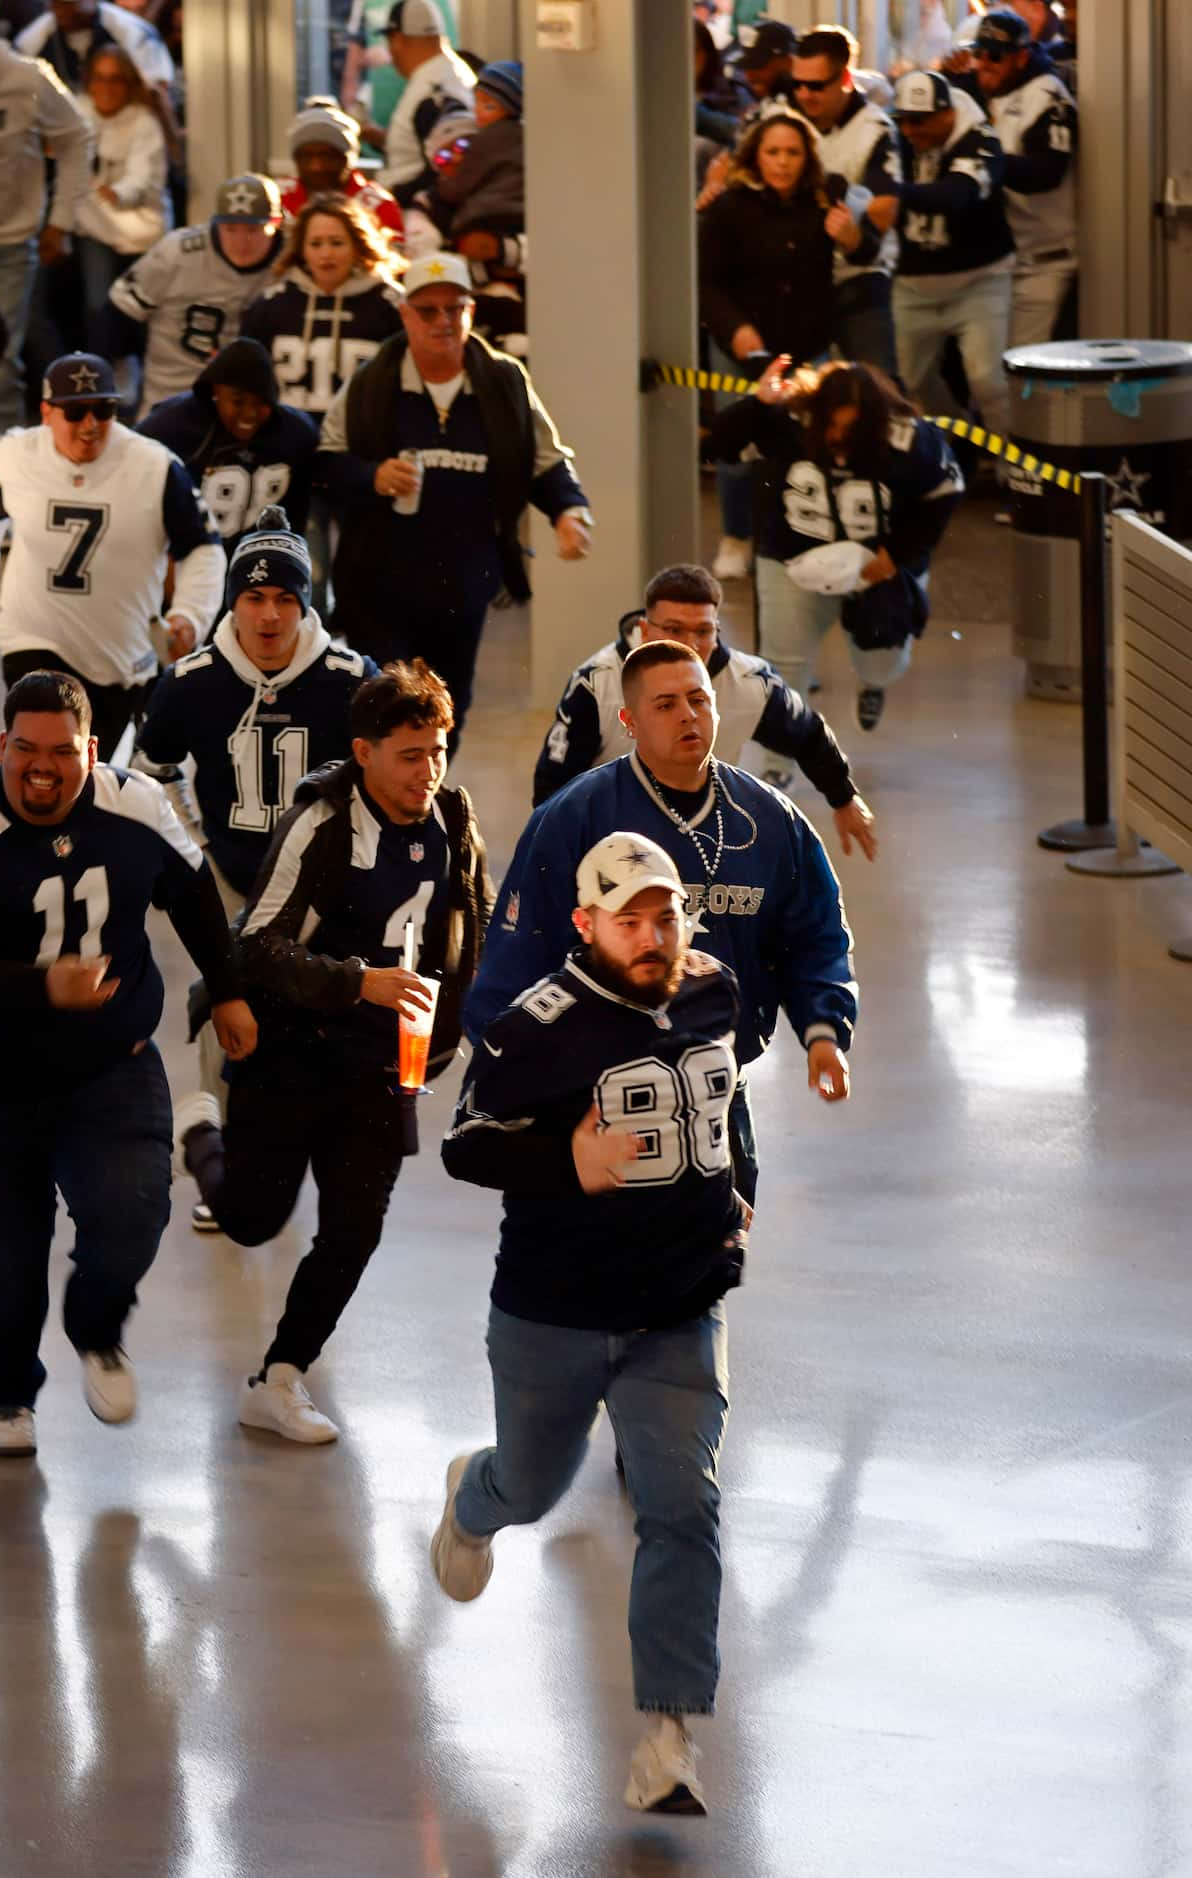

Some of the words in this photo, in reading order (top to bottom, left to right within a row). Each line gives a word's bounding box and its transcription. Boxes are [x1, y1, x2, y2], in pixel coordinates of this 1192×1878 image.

[46, 499, 110, 595] 7
[227, 725, 308, 833] 11
[547, 723, 570, 765] 4
[32, 864, 111, 968] 11
[382, 879, 436, 970] 4
[593, 1041, 738, 1188] 88
